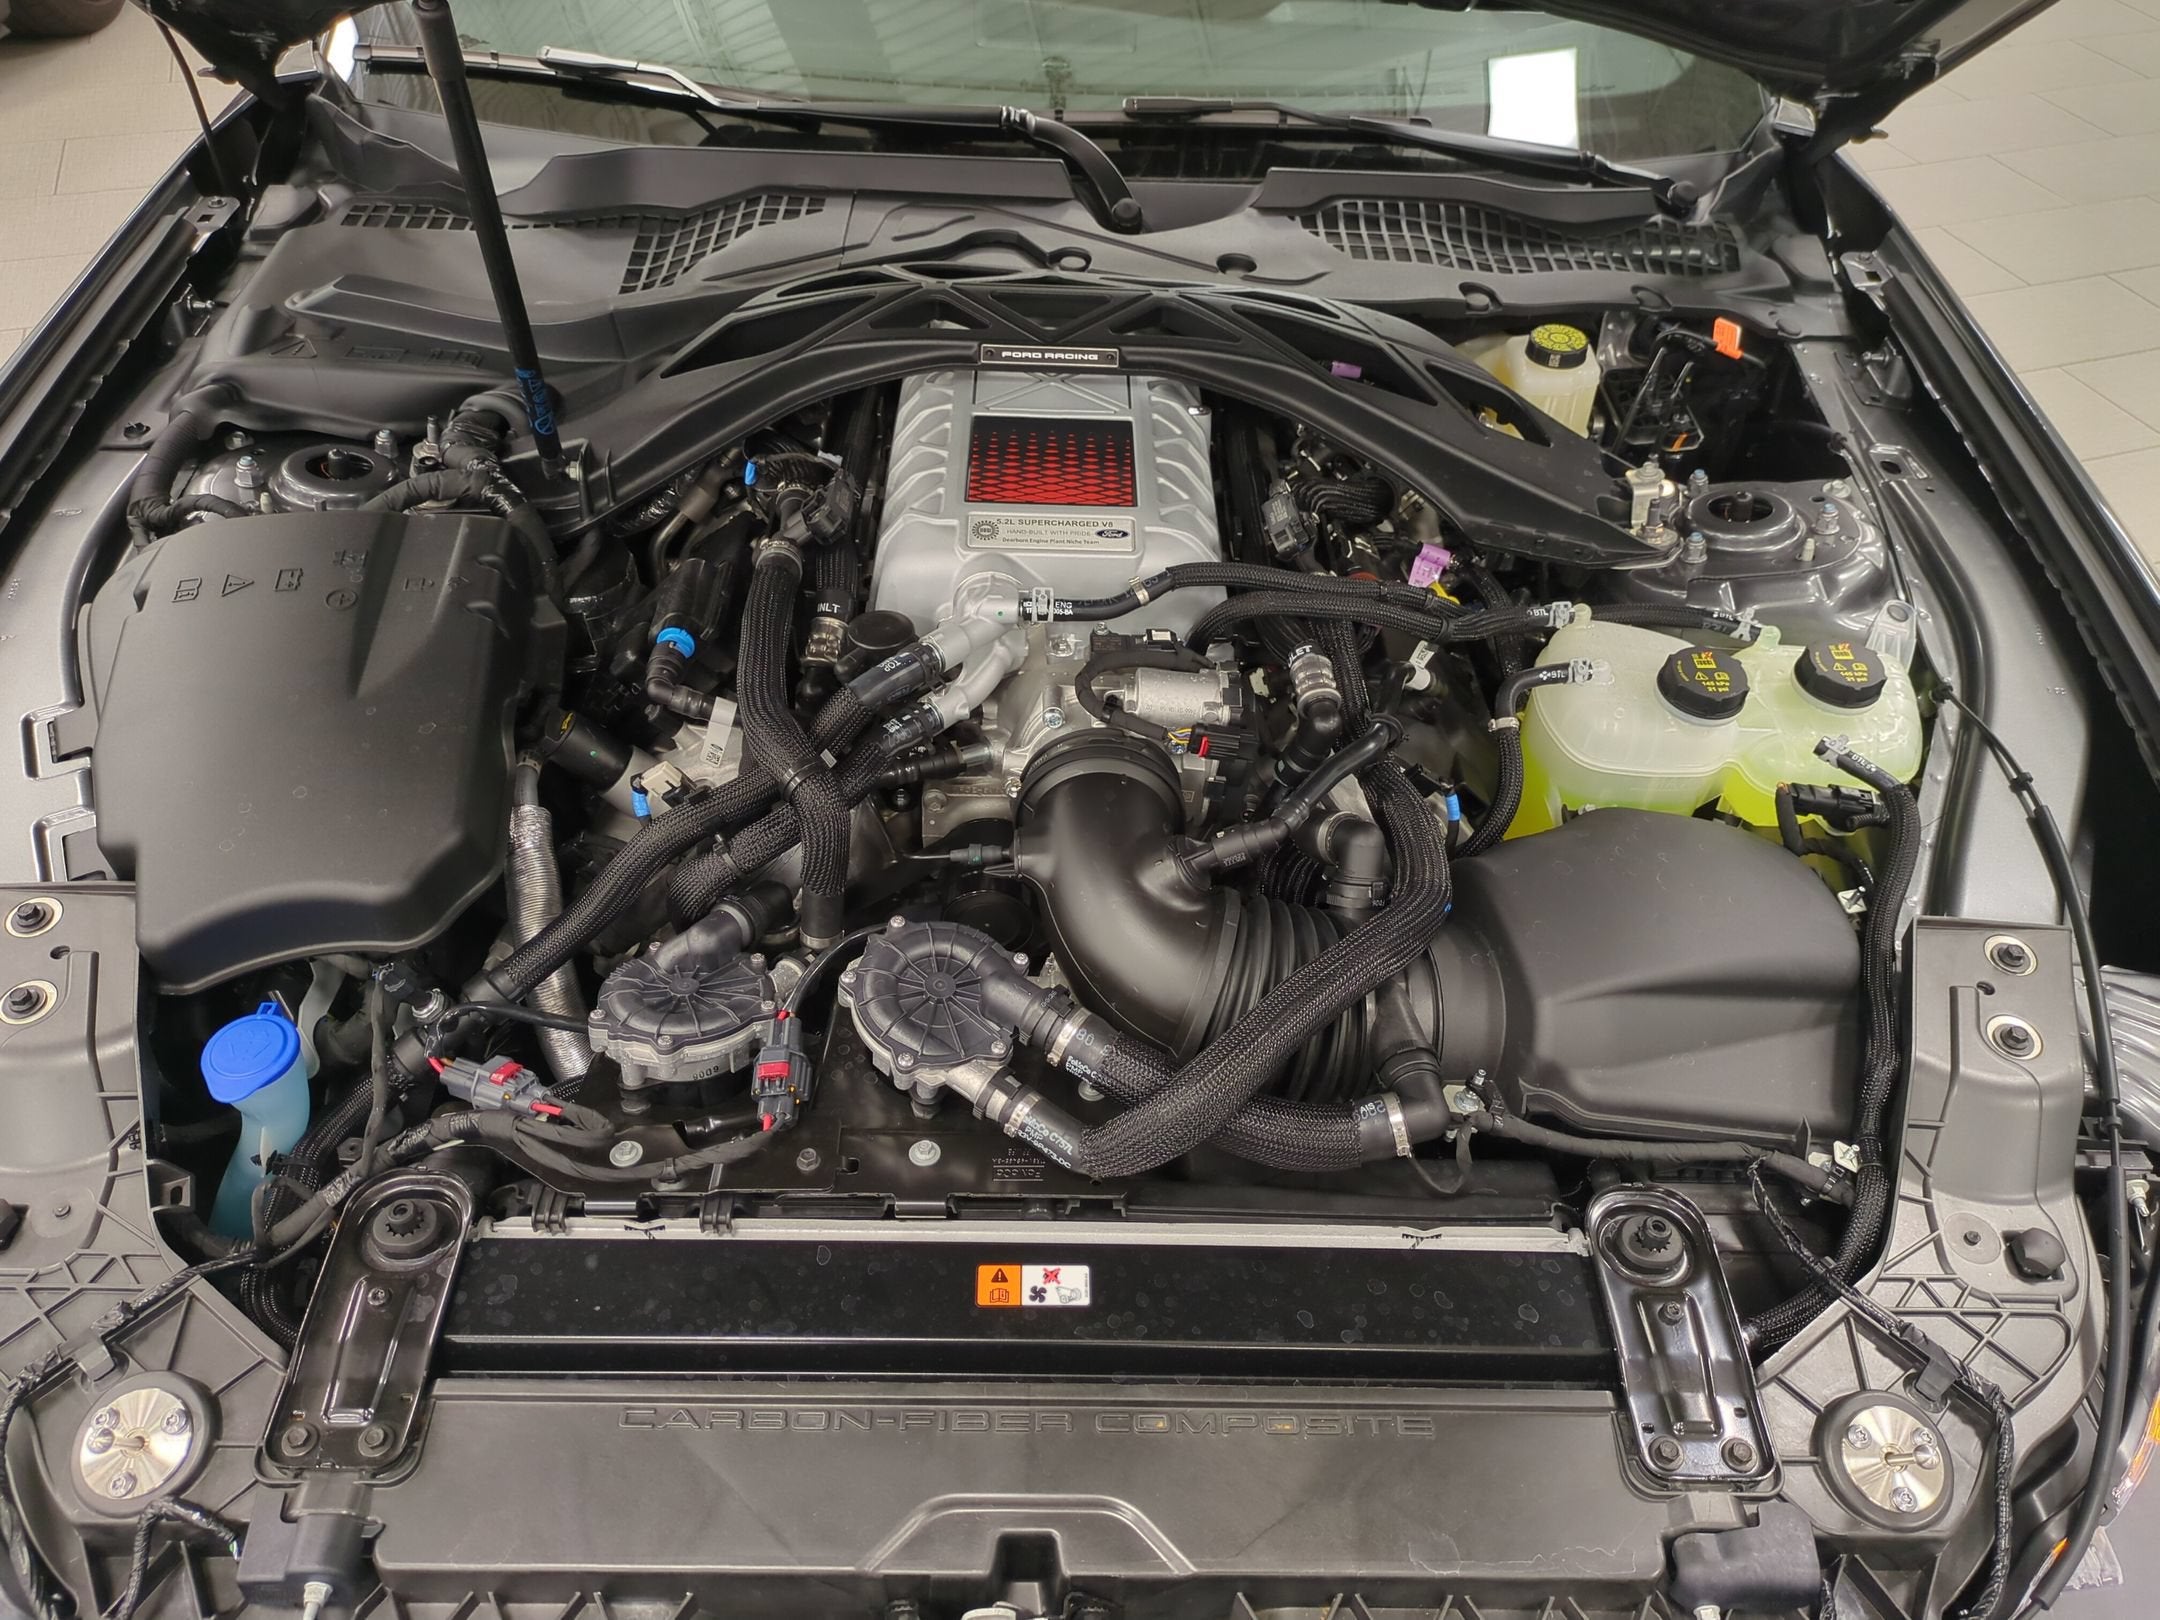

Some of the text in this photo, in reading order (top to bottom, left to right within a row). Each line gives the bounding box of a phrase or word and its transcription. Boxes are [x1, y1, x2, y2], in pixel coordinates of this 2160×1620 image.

[1002, 350, 1099, 361] FORD RACING
[1018, 519, 1099, 527] SUPERCHARGED
[1100, 529, 1126, 538] Ford
[817, 602, 841, 614] INLT
[617, 1407, 1436, 1438] CARBON-FIBER COMPOSITE
